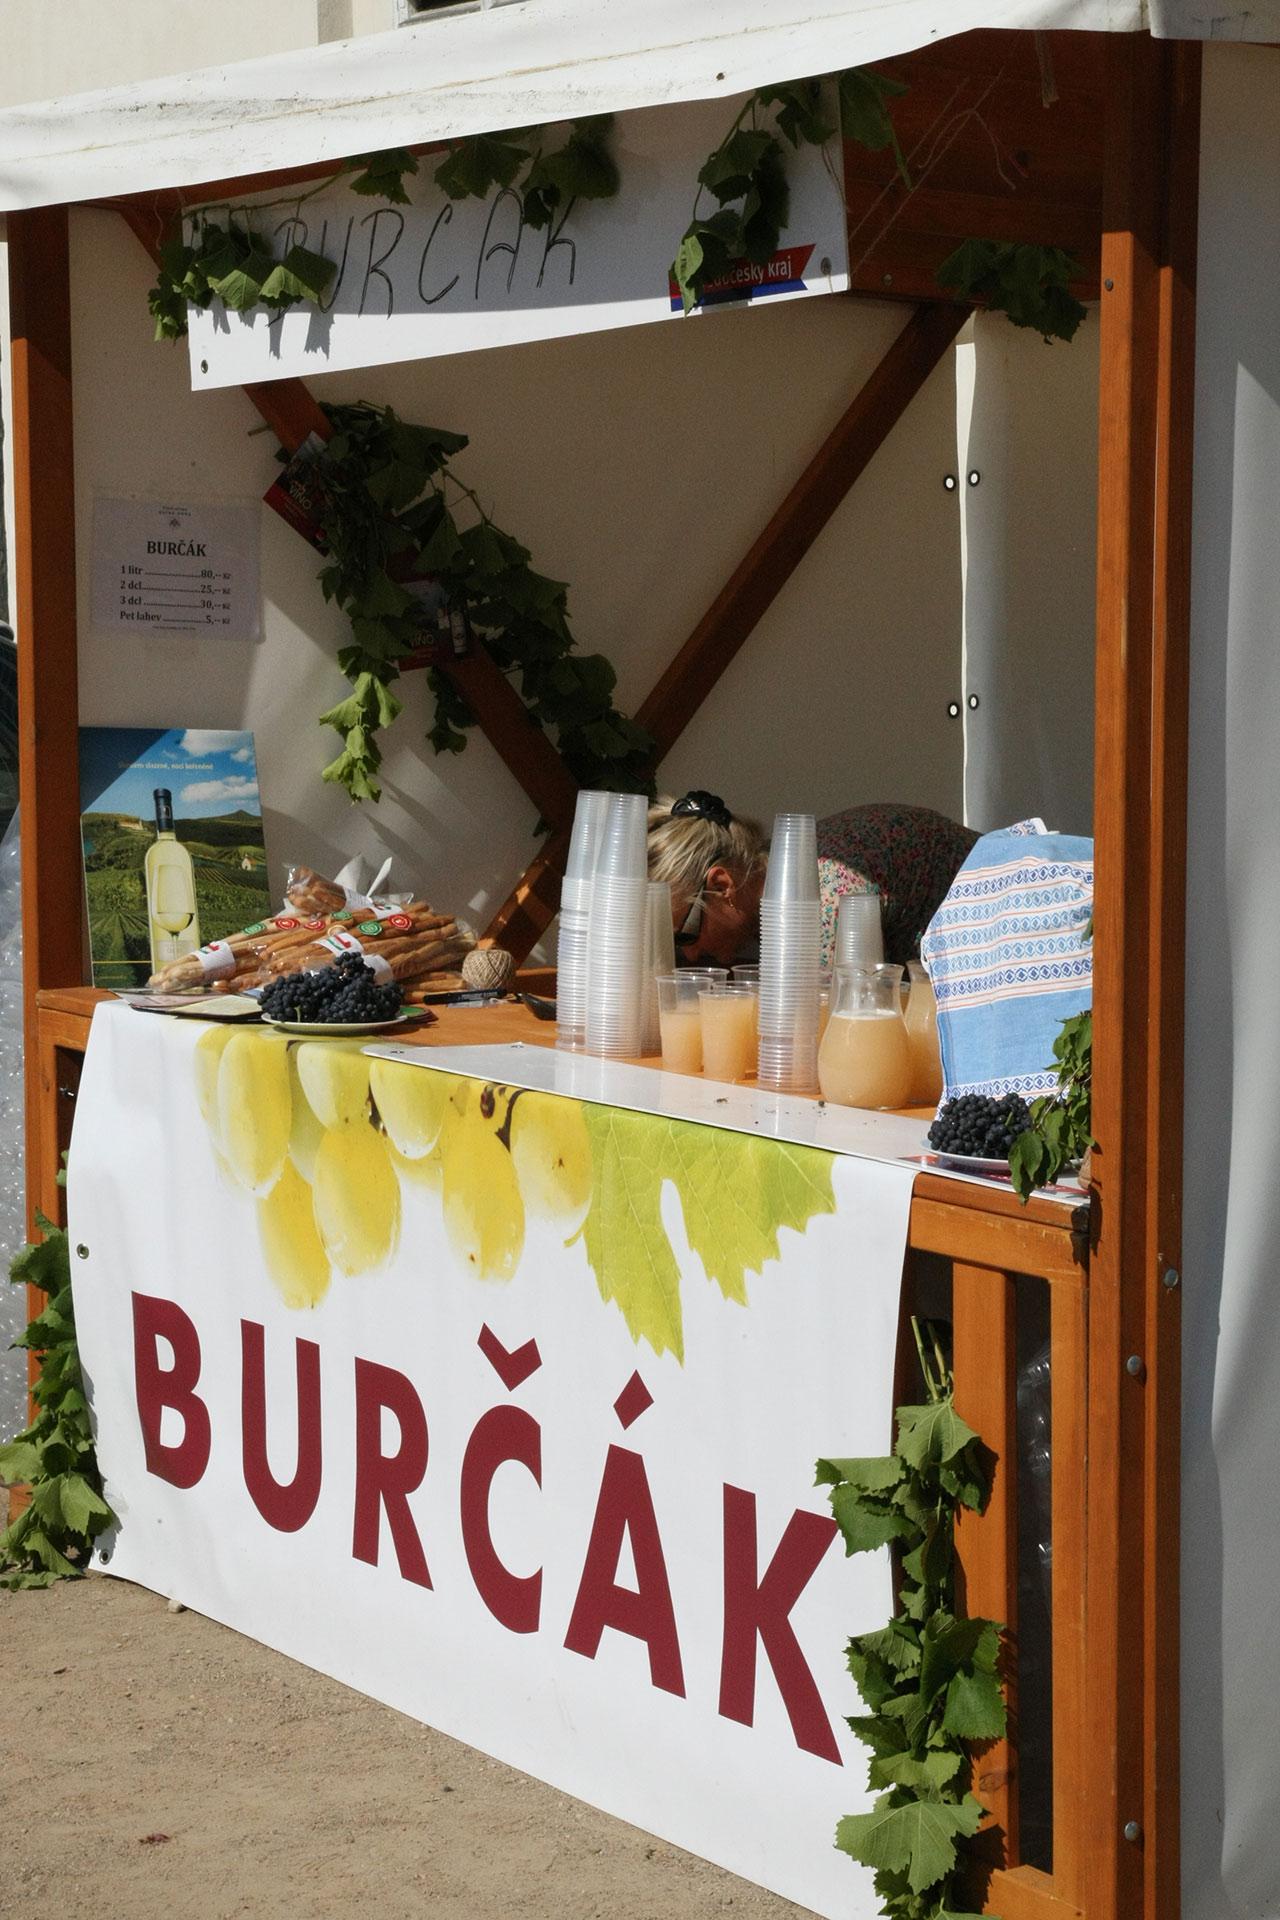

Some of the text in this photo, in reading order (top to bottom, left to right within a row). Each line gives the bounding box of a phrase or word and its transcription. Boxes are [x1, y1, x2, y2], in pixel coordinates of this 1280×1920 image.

[767, 256, 792, 279] kraj
[147, 539, 207, 557] BURČÁK
[121, 564, 126, 575] 1
[128, 564, 143, 575] litr
[120, 580, 126, 590] 2
[128, 580, 142, 590] dcl
[120, 595, 126, 605] 3
[128, 595, 142, 606] dcl
[120, 610, 135, 620] Pet
[131, 1291, 845, 1767] BURČÁK
